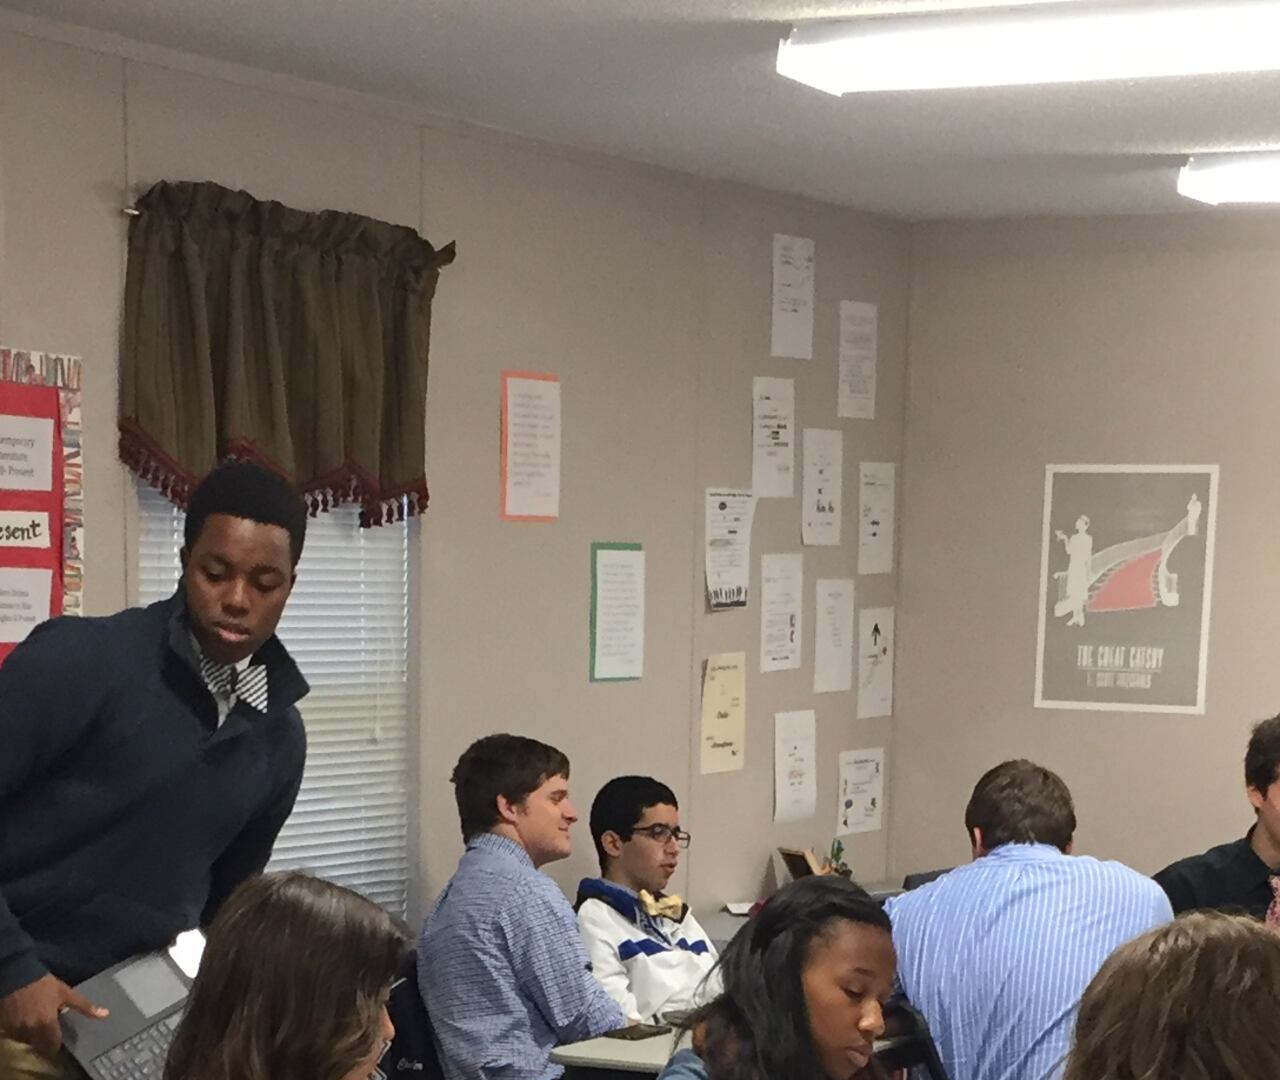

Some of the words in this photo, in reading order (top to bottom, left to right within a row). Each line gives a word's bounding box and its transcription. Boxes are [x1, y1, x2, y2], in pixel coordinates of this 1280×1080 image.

[1077, 644, 1094, 667] THE
[1097, 645, 1126, 668] GREAT
[1129, 646, 1164, 669] GATSBY
